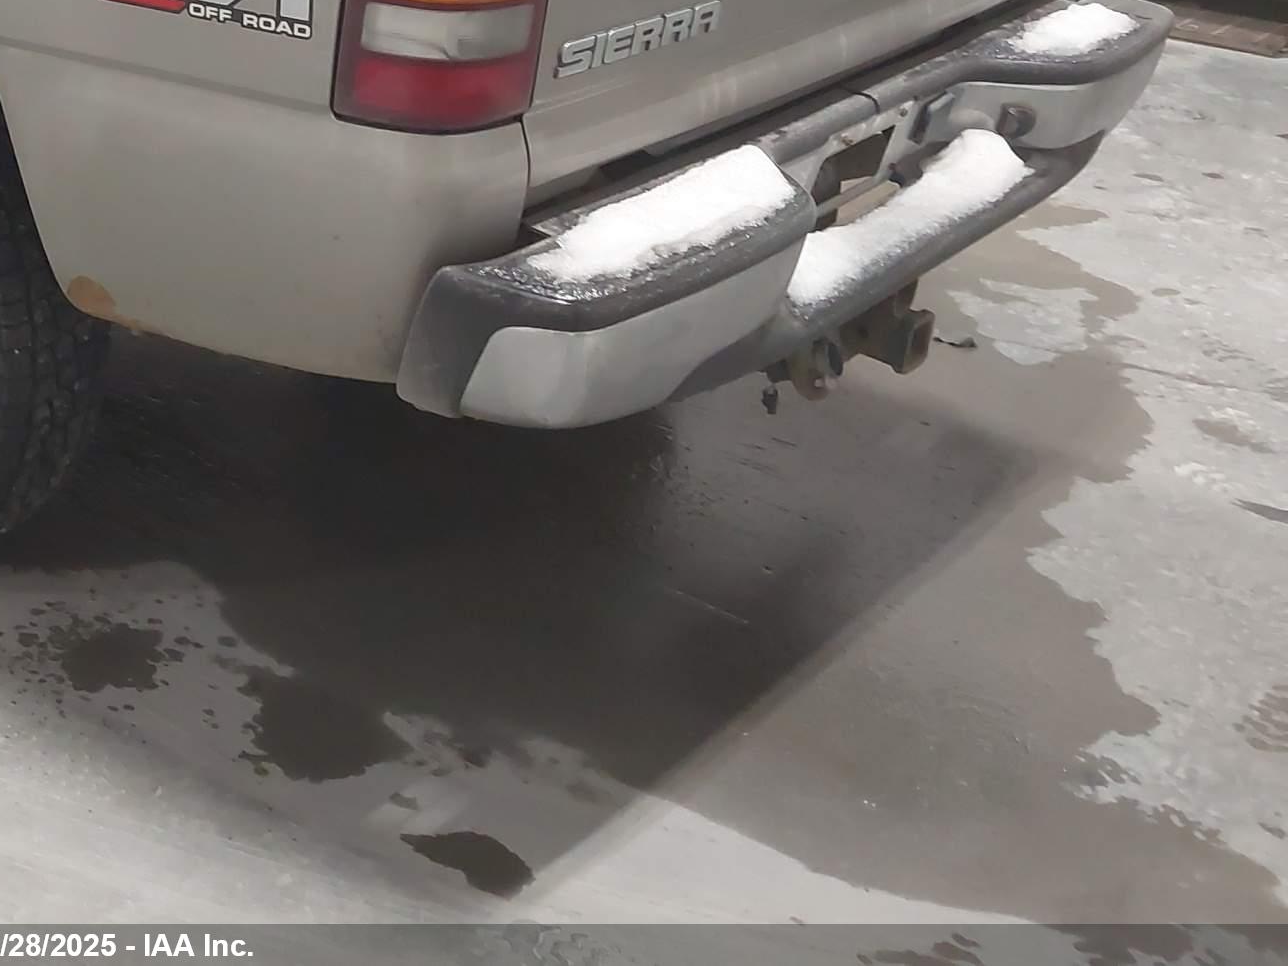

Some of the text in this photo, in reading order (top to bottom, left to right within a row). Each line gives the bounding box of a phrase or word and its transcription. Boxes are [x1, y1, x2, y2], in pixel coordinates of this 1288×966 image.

[187, 2, 312, 39] OFF ROAD
[554, 0, 721, 79] SIERRA
